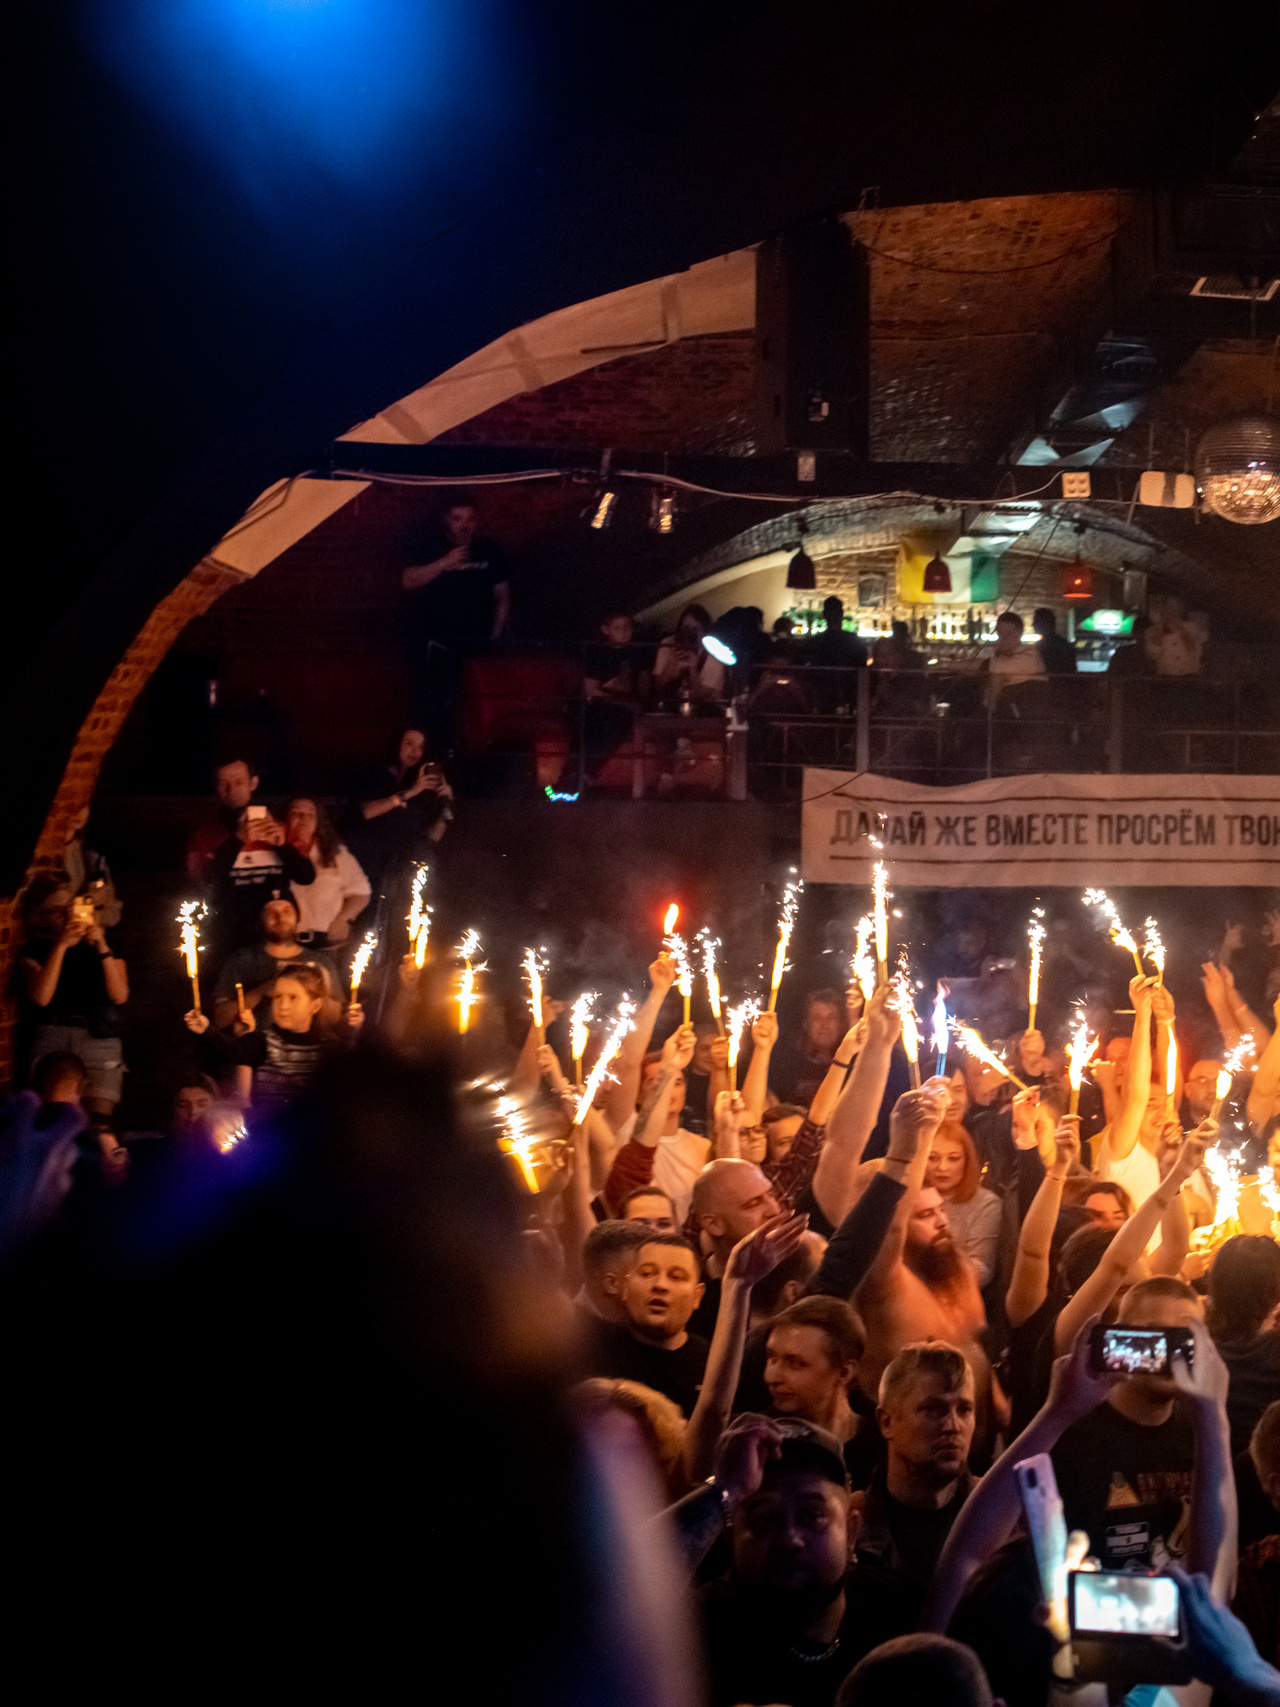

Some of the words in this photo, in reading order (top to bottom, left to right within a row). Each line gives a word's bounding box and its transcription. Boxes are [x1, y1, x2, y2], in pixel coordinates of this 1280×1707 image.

[934, 814, 978, 846] ЖЕ
[985, 813, 1089, 847] ВМЕСТЕ
[1096, 808, 1216, 846] ПРОСРЁМ
